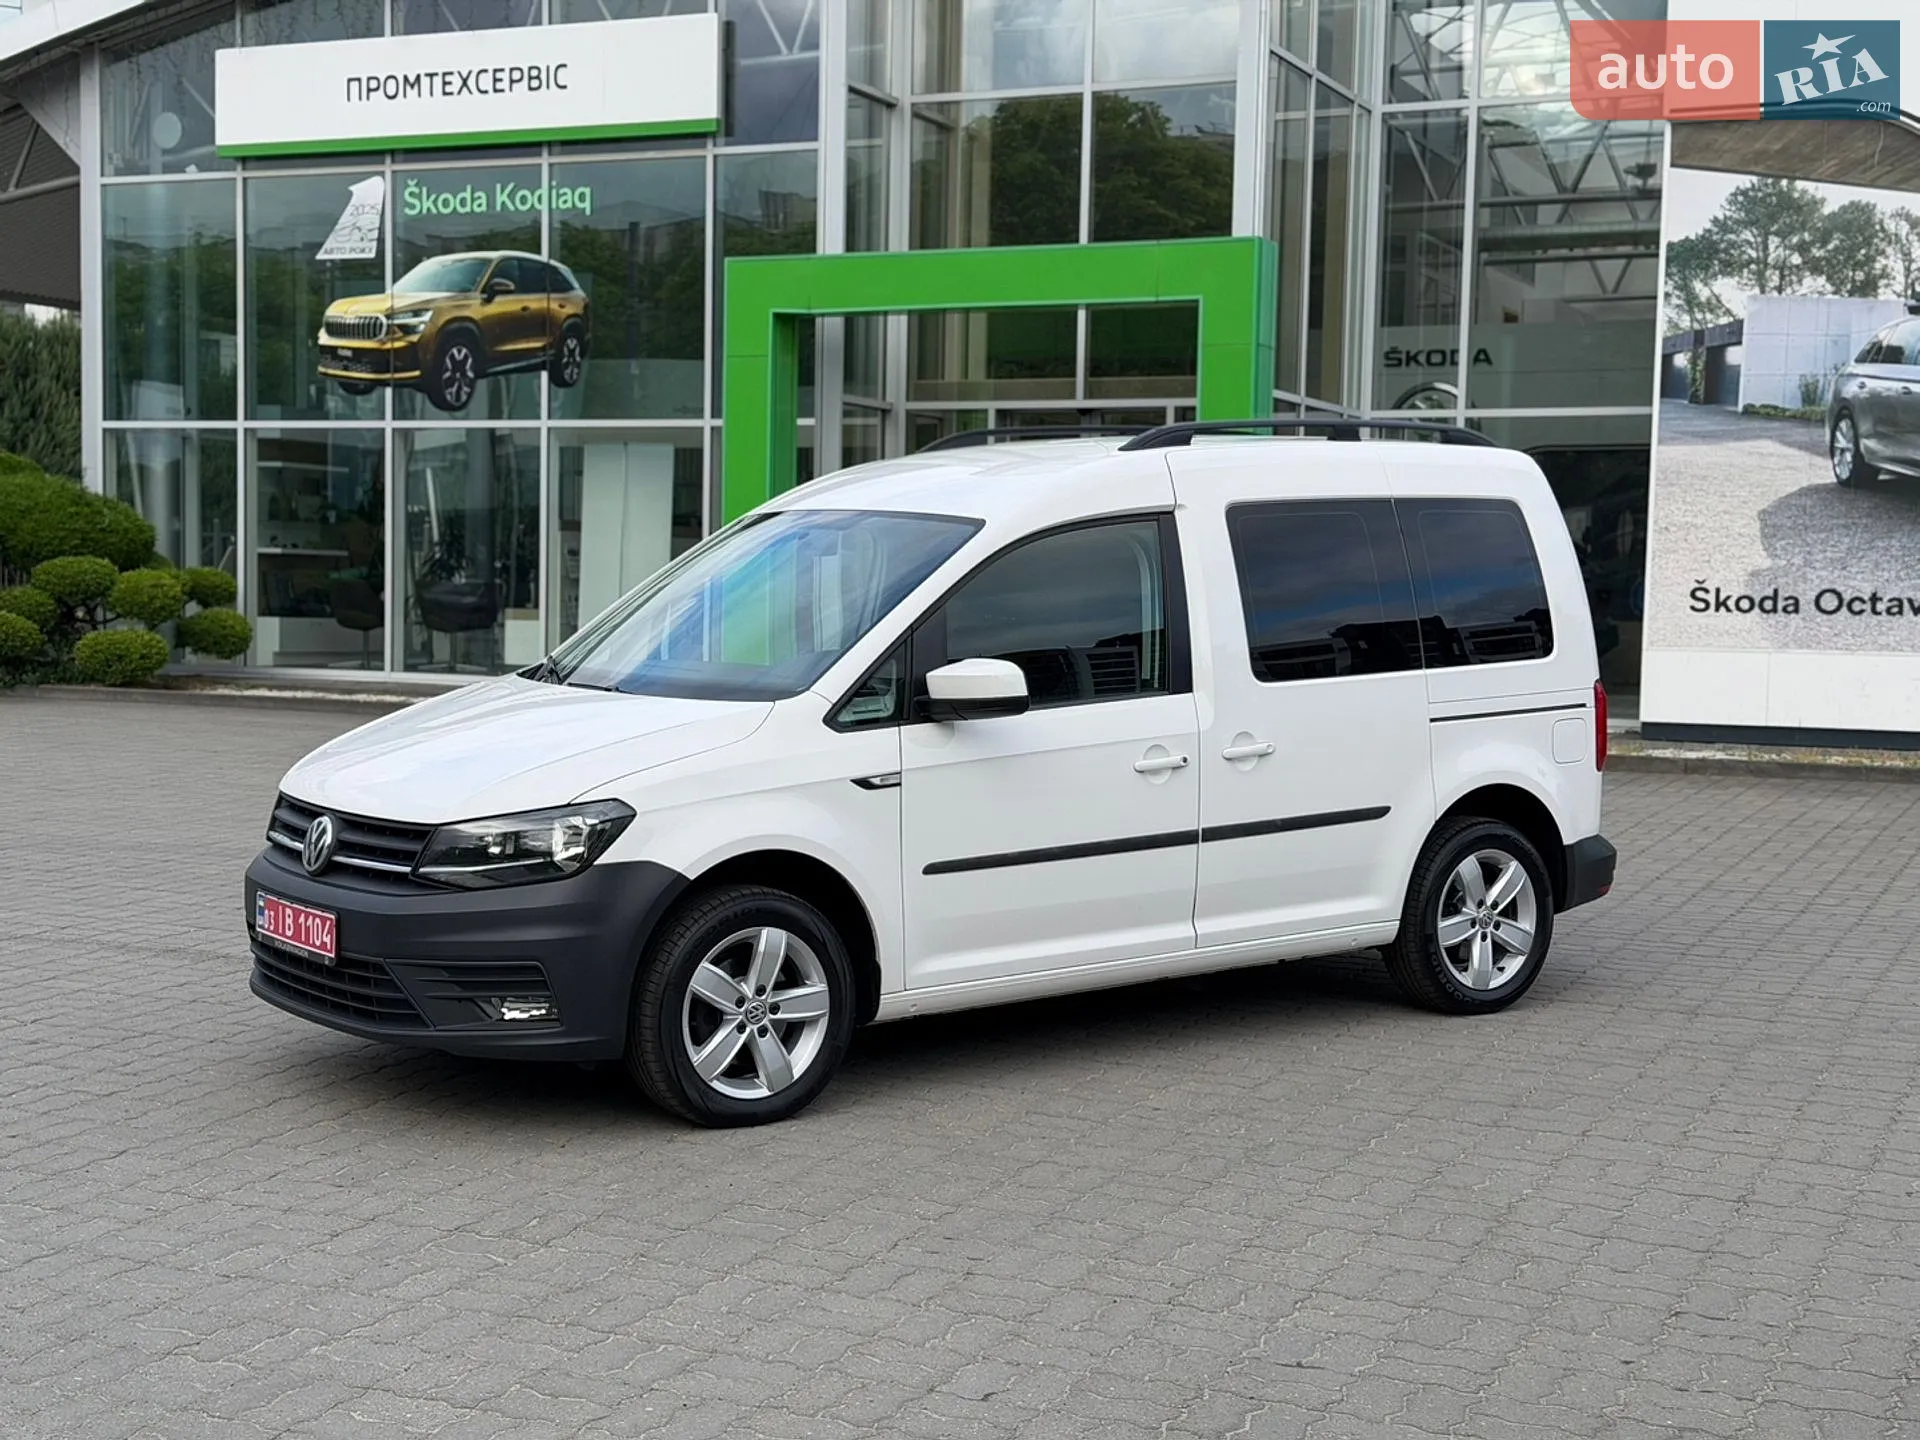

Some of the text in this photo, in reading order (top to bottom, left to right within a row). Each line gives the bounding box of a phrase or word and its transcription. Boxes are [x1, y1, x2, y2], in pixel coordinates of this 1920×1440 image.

[345, 63, 569, 102] ПРОМТЕХСЕРВІС
[403, 178, 592, 217] Škoda Kodiaq
[1689, 578, 1800, 614] Škoda
[298, 912, 331, 950] 1104
